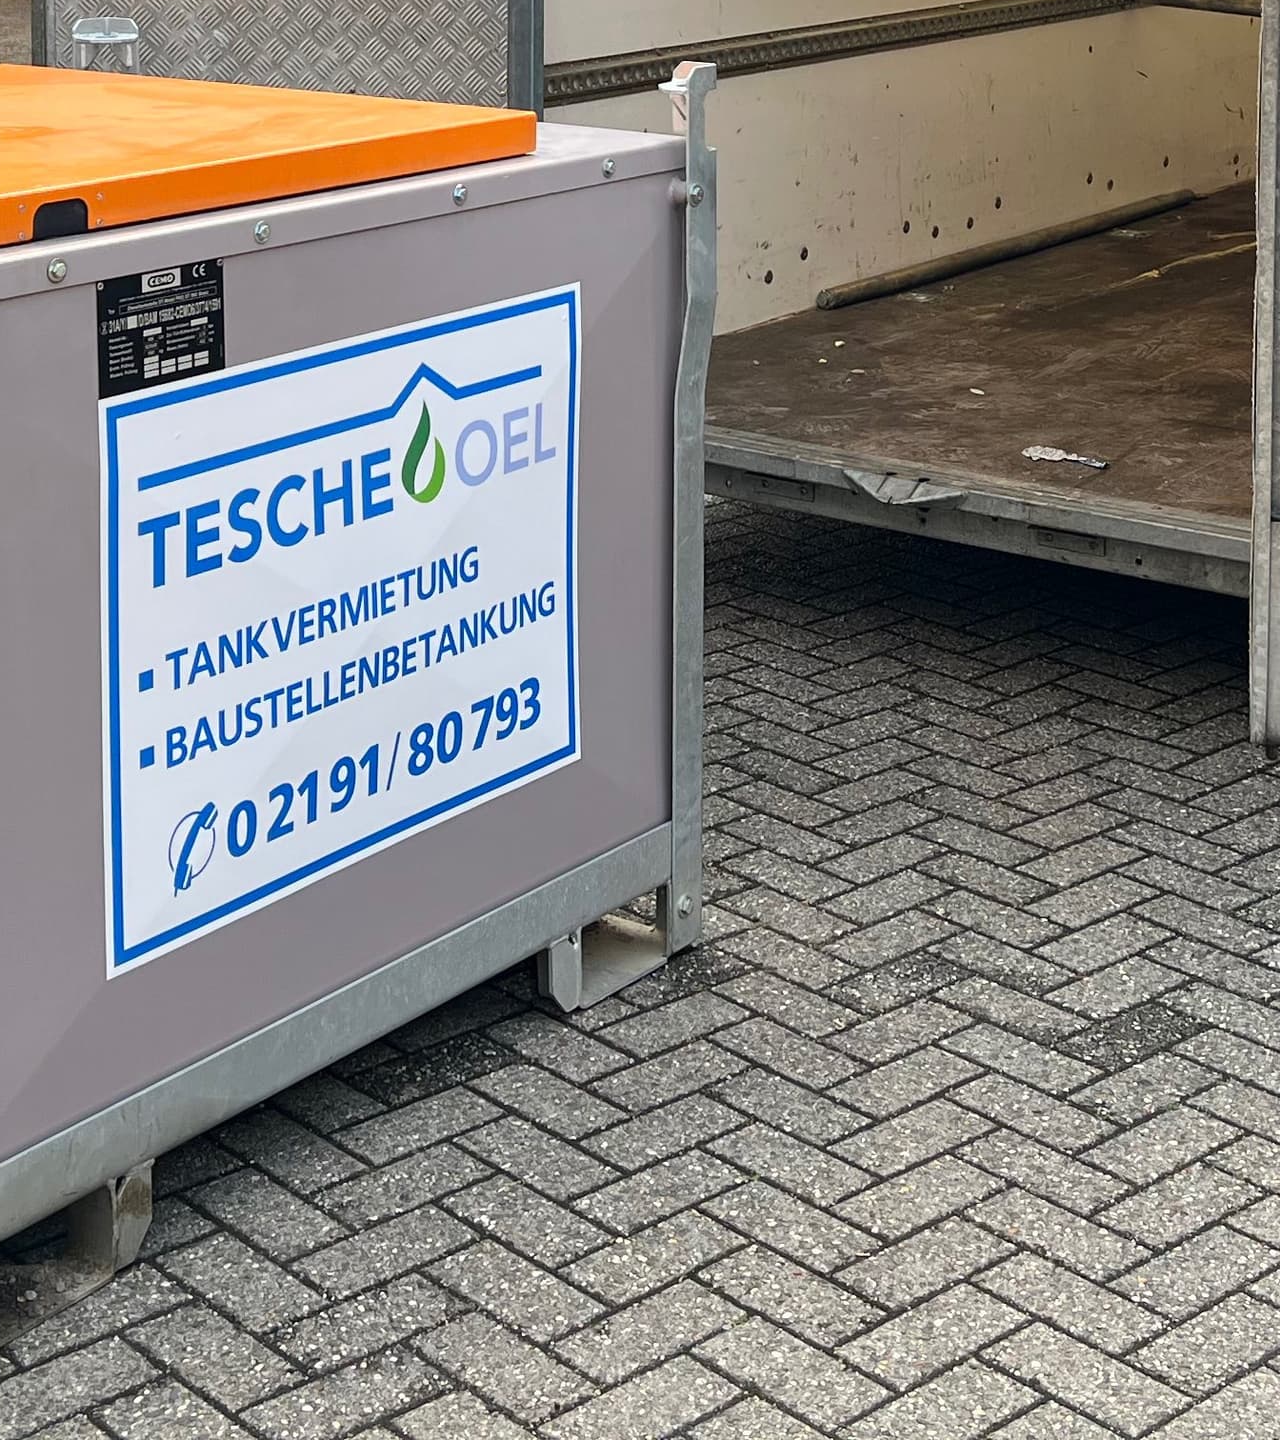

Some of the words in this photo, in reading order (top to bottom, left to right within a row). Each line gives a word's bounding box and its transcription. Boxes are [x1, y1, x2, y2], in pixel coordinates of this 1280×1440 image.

[138, 448, 394, 589] TESCHE
[454, 402, 557, 488] OEL
[165, 545, 479, 690] TANKVERMIETUNG
[165, 581, 556, 769] BAUSTELLENBETANKUNG
